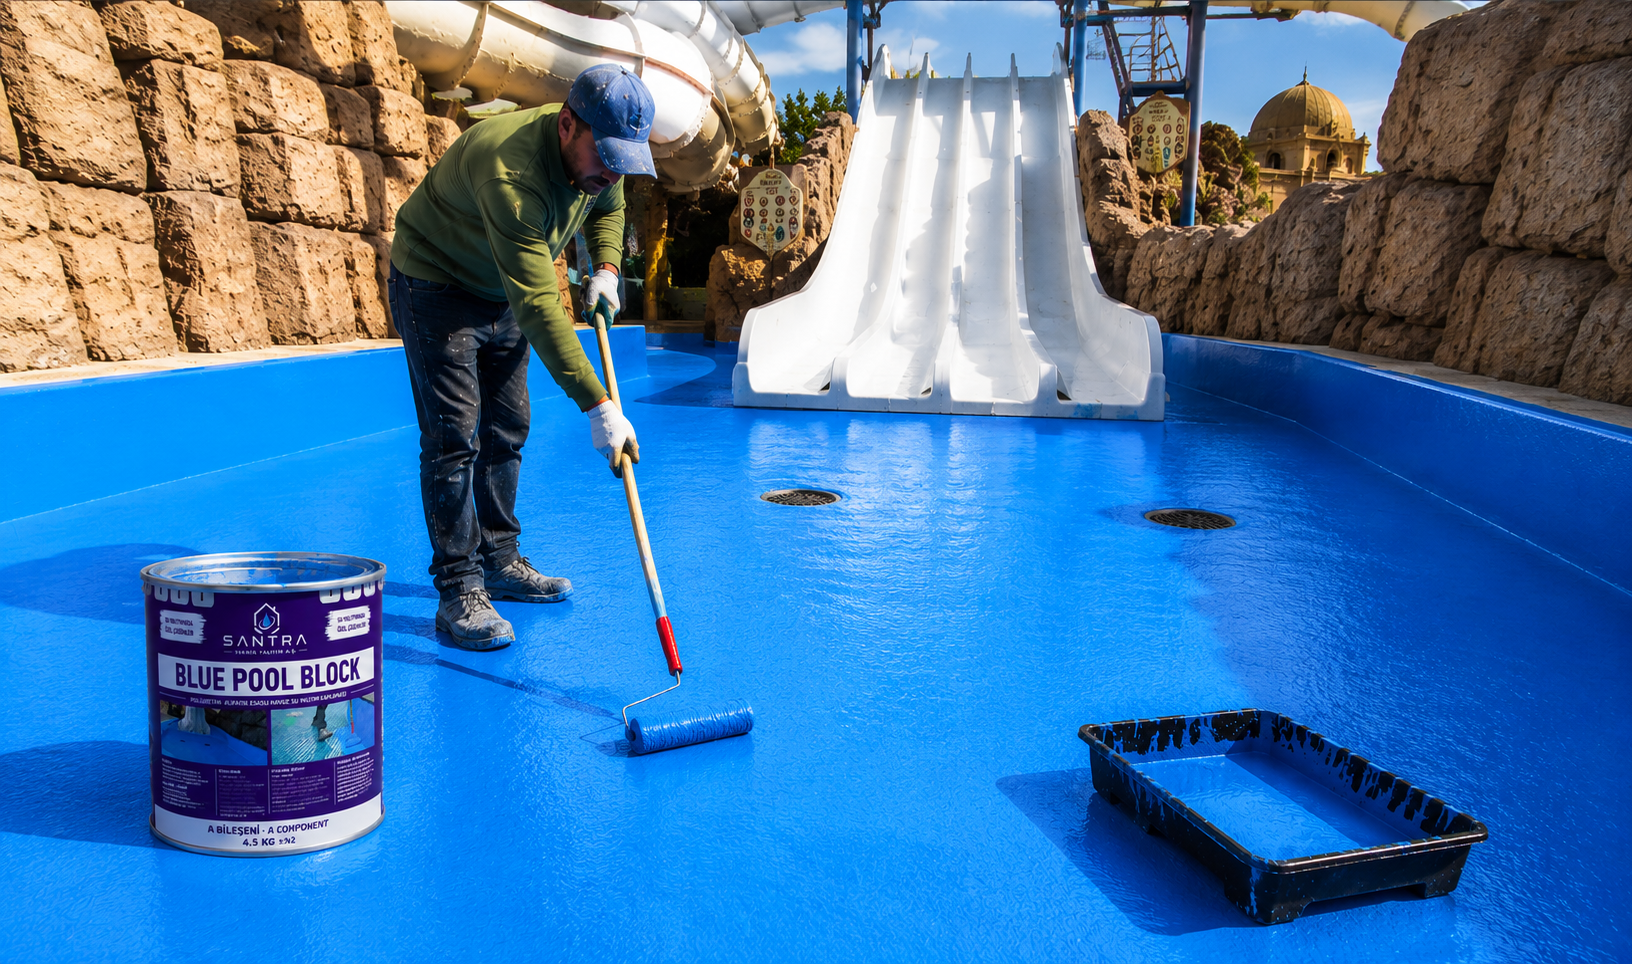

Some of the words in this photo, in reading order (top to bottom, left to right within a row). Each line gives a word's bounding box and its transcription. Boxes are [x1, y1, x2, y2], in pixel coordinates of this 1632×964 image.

[223, 634, 307, 647] SANTRA
[175, 662, 226, 691] BLUE
[232, 667, 294, 692] POOL
[300, 656, 361, 690] BLOCK
[207, 825, 215, 834] A
[216, 824, 260, 836] BİLEŞENİ
[267, 826, 275, 835] A
[242, 838, 259, 847] 4.5
[261, 838, 276, 847] KG
